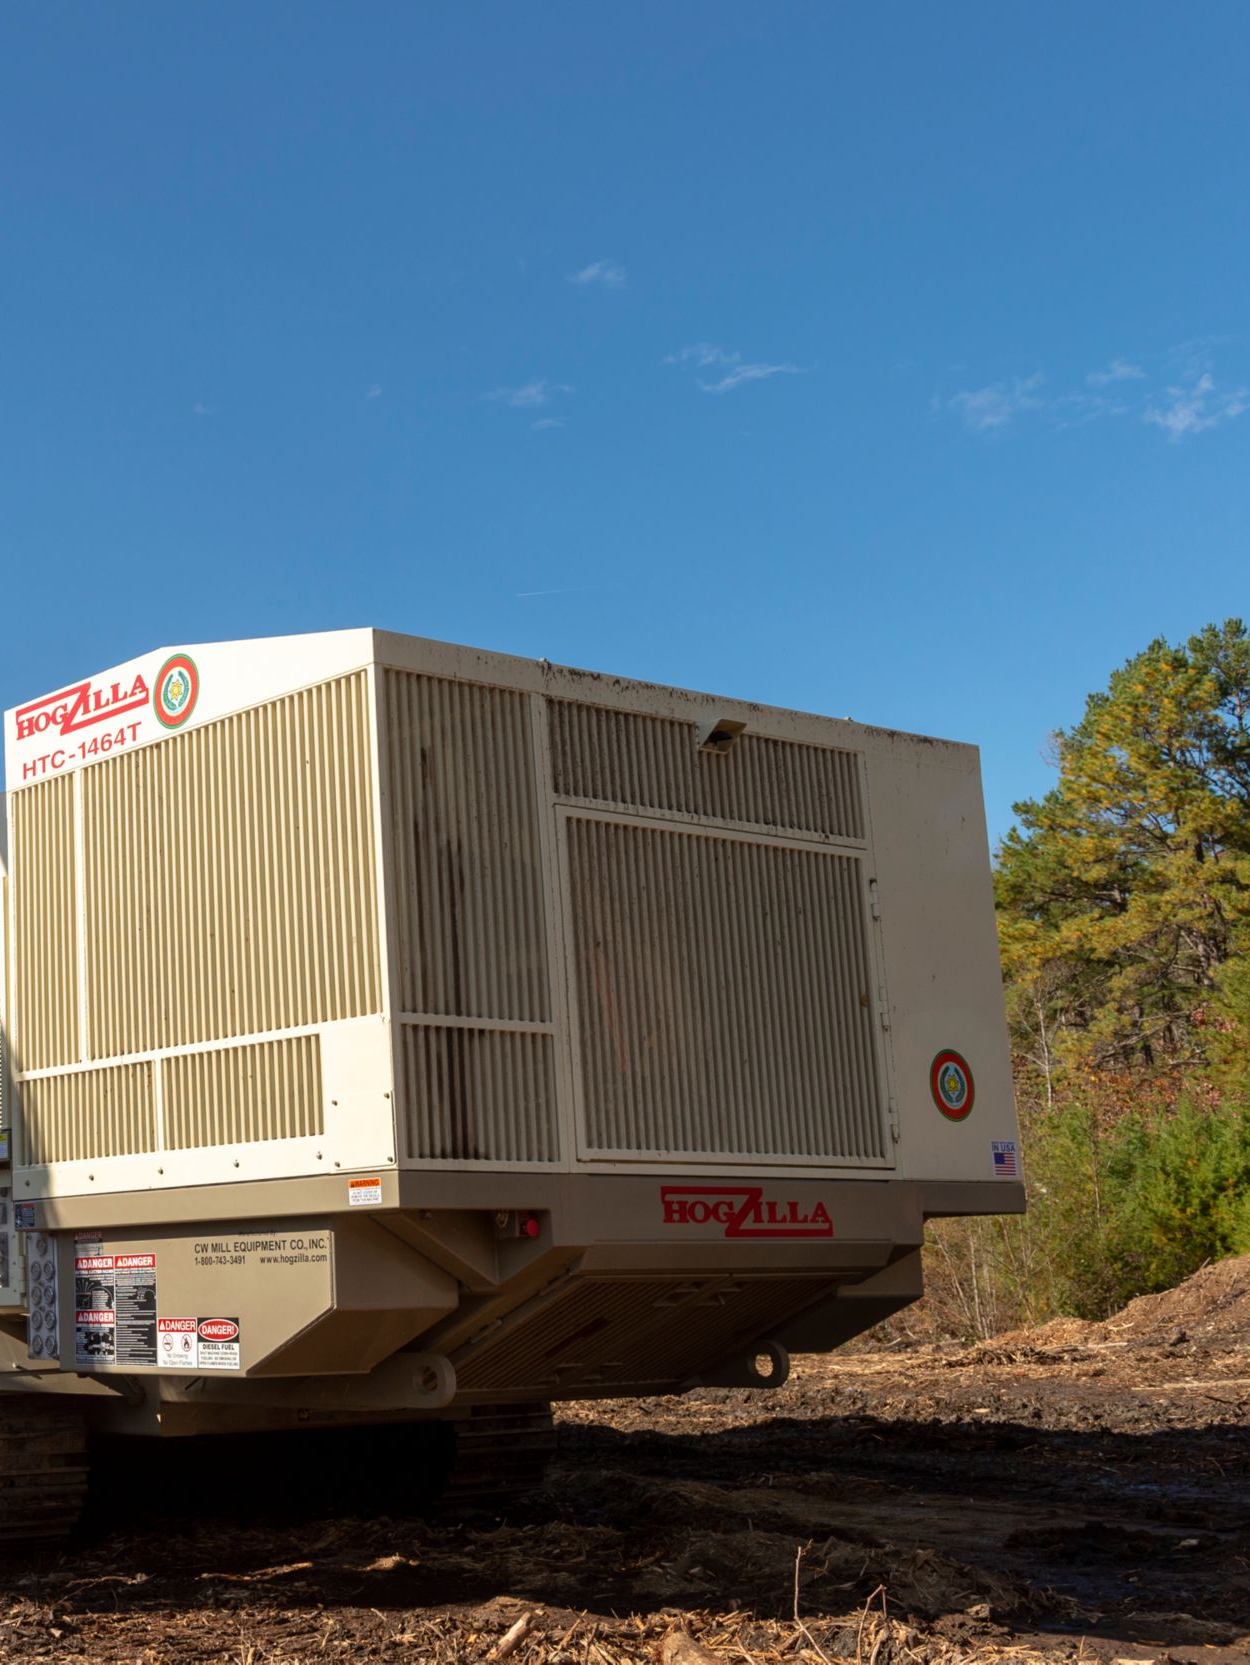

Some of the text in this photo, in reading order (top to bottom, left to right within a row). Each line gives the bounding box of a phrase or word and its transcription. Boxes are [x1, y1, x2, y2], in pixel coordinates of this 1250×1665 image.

[15, 674, 149, 741] HOGZILLA
[23, 721, 142, 780] HTC-1464T
[1000, 1144, 1016, 1152] USA
[660, 1185, 834, 1238] HOGZILLA
[194, 1243, 209, 1254] CW
[211, 1243, 231, 1253] MILL
[234, 1240, 287, 1252] EQUIPMENT
[82, 1258, 112, 1269] DANGER
[122, 1256, 153, 1267] DANGER
[194, 1253, 327, 1266] 1-800-743-3491 www.hogzilla.com
[83, 1312, 113, 1322] DANGER
[166, 1320, 196, 1331] DANGER
[202, 1325, 234, 1335] DANGER!
